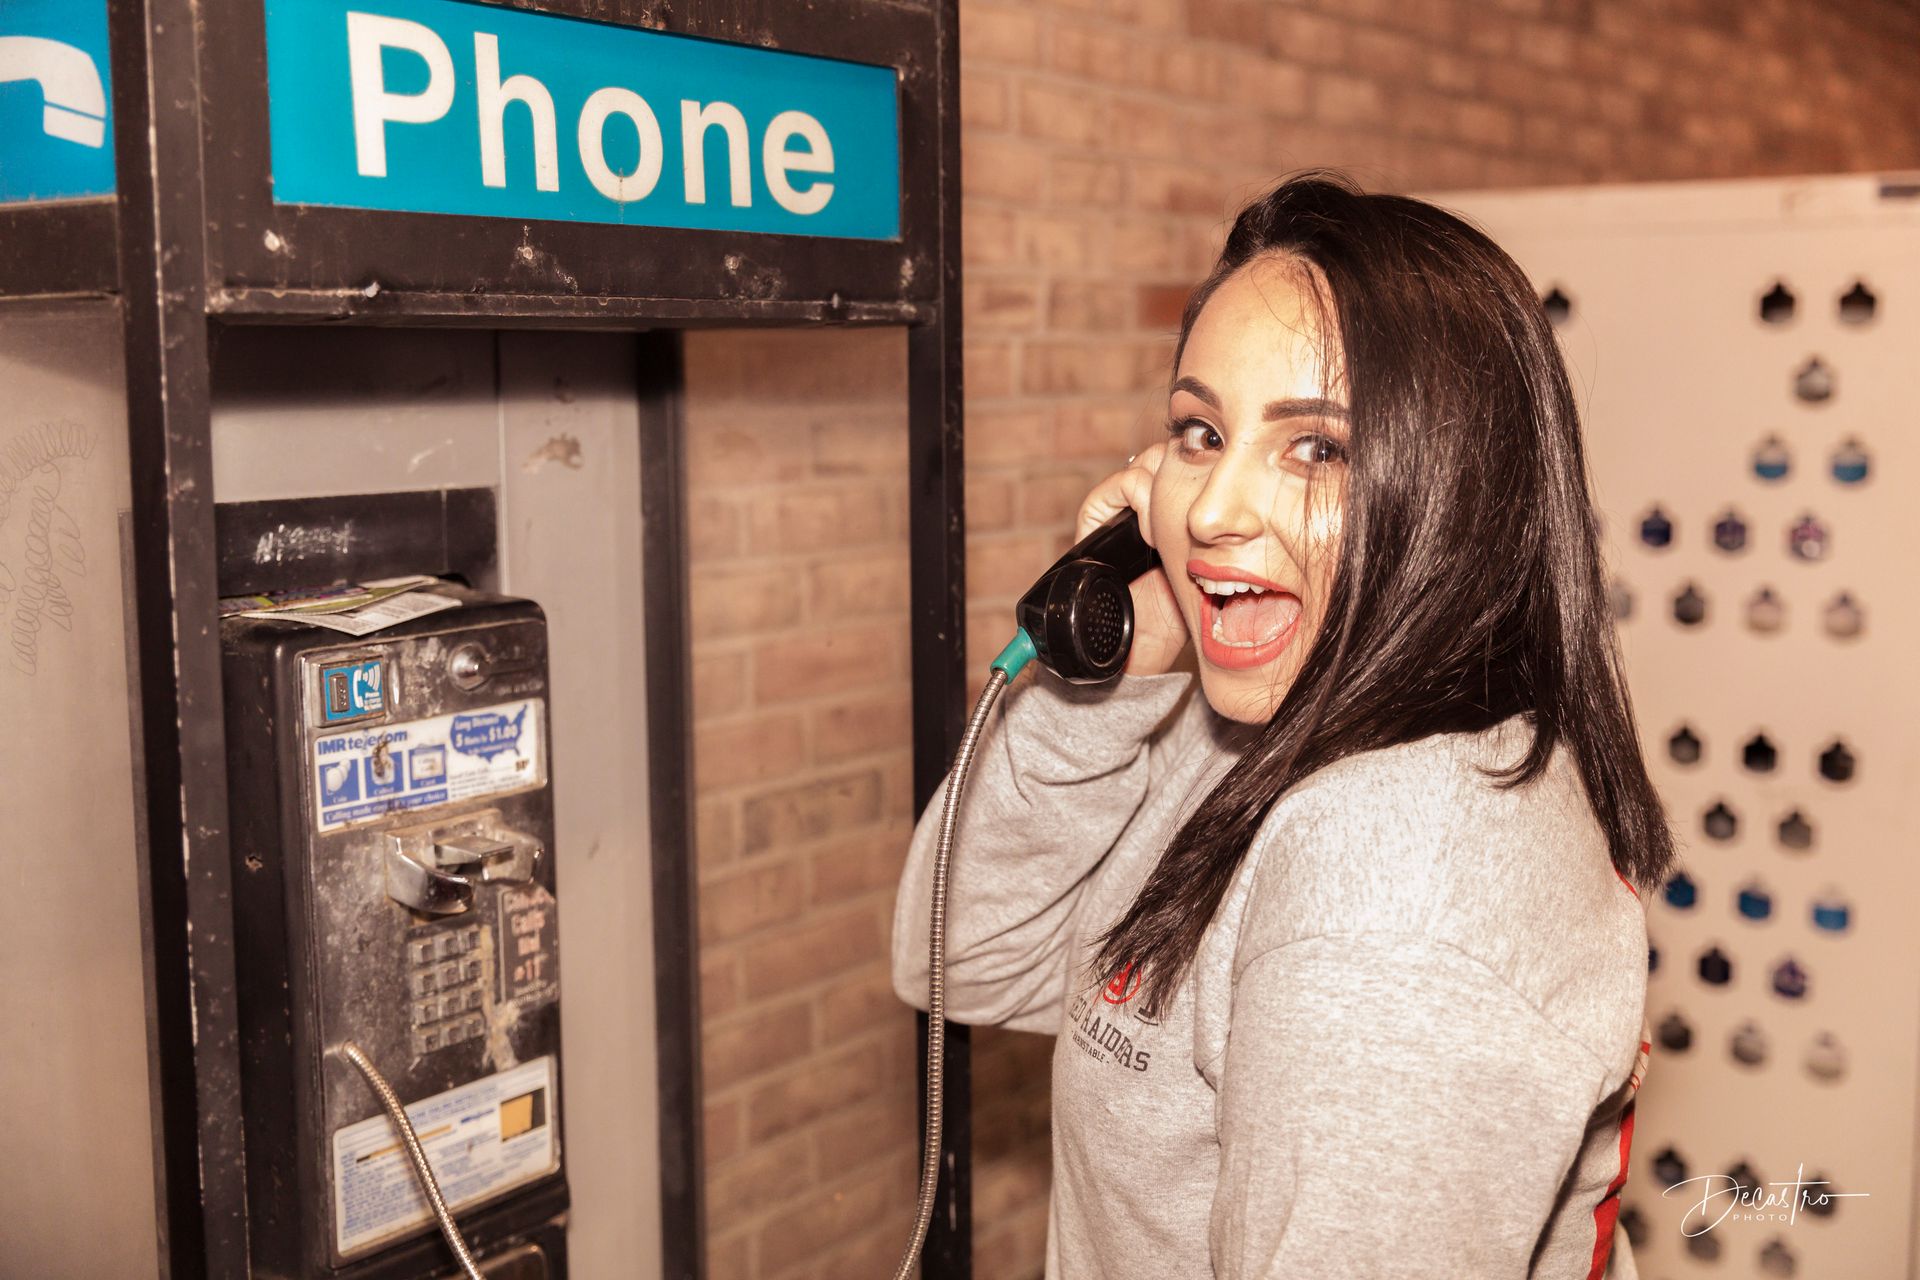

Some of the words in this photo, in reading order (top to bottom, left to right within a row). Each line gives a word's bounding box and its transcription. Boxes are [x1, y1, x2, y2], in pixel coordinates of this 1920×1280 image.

[346, 10, 835, 216] Phone
[317, 737, 346, 755] IMR
[347, 730, 409, 751] telecom
